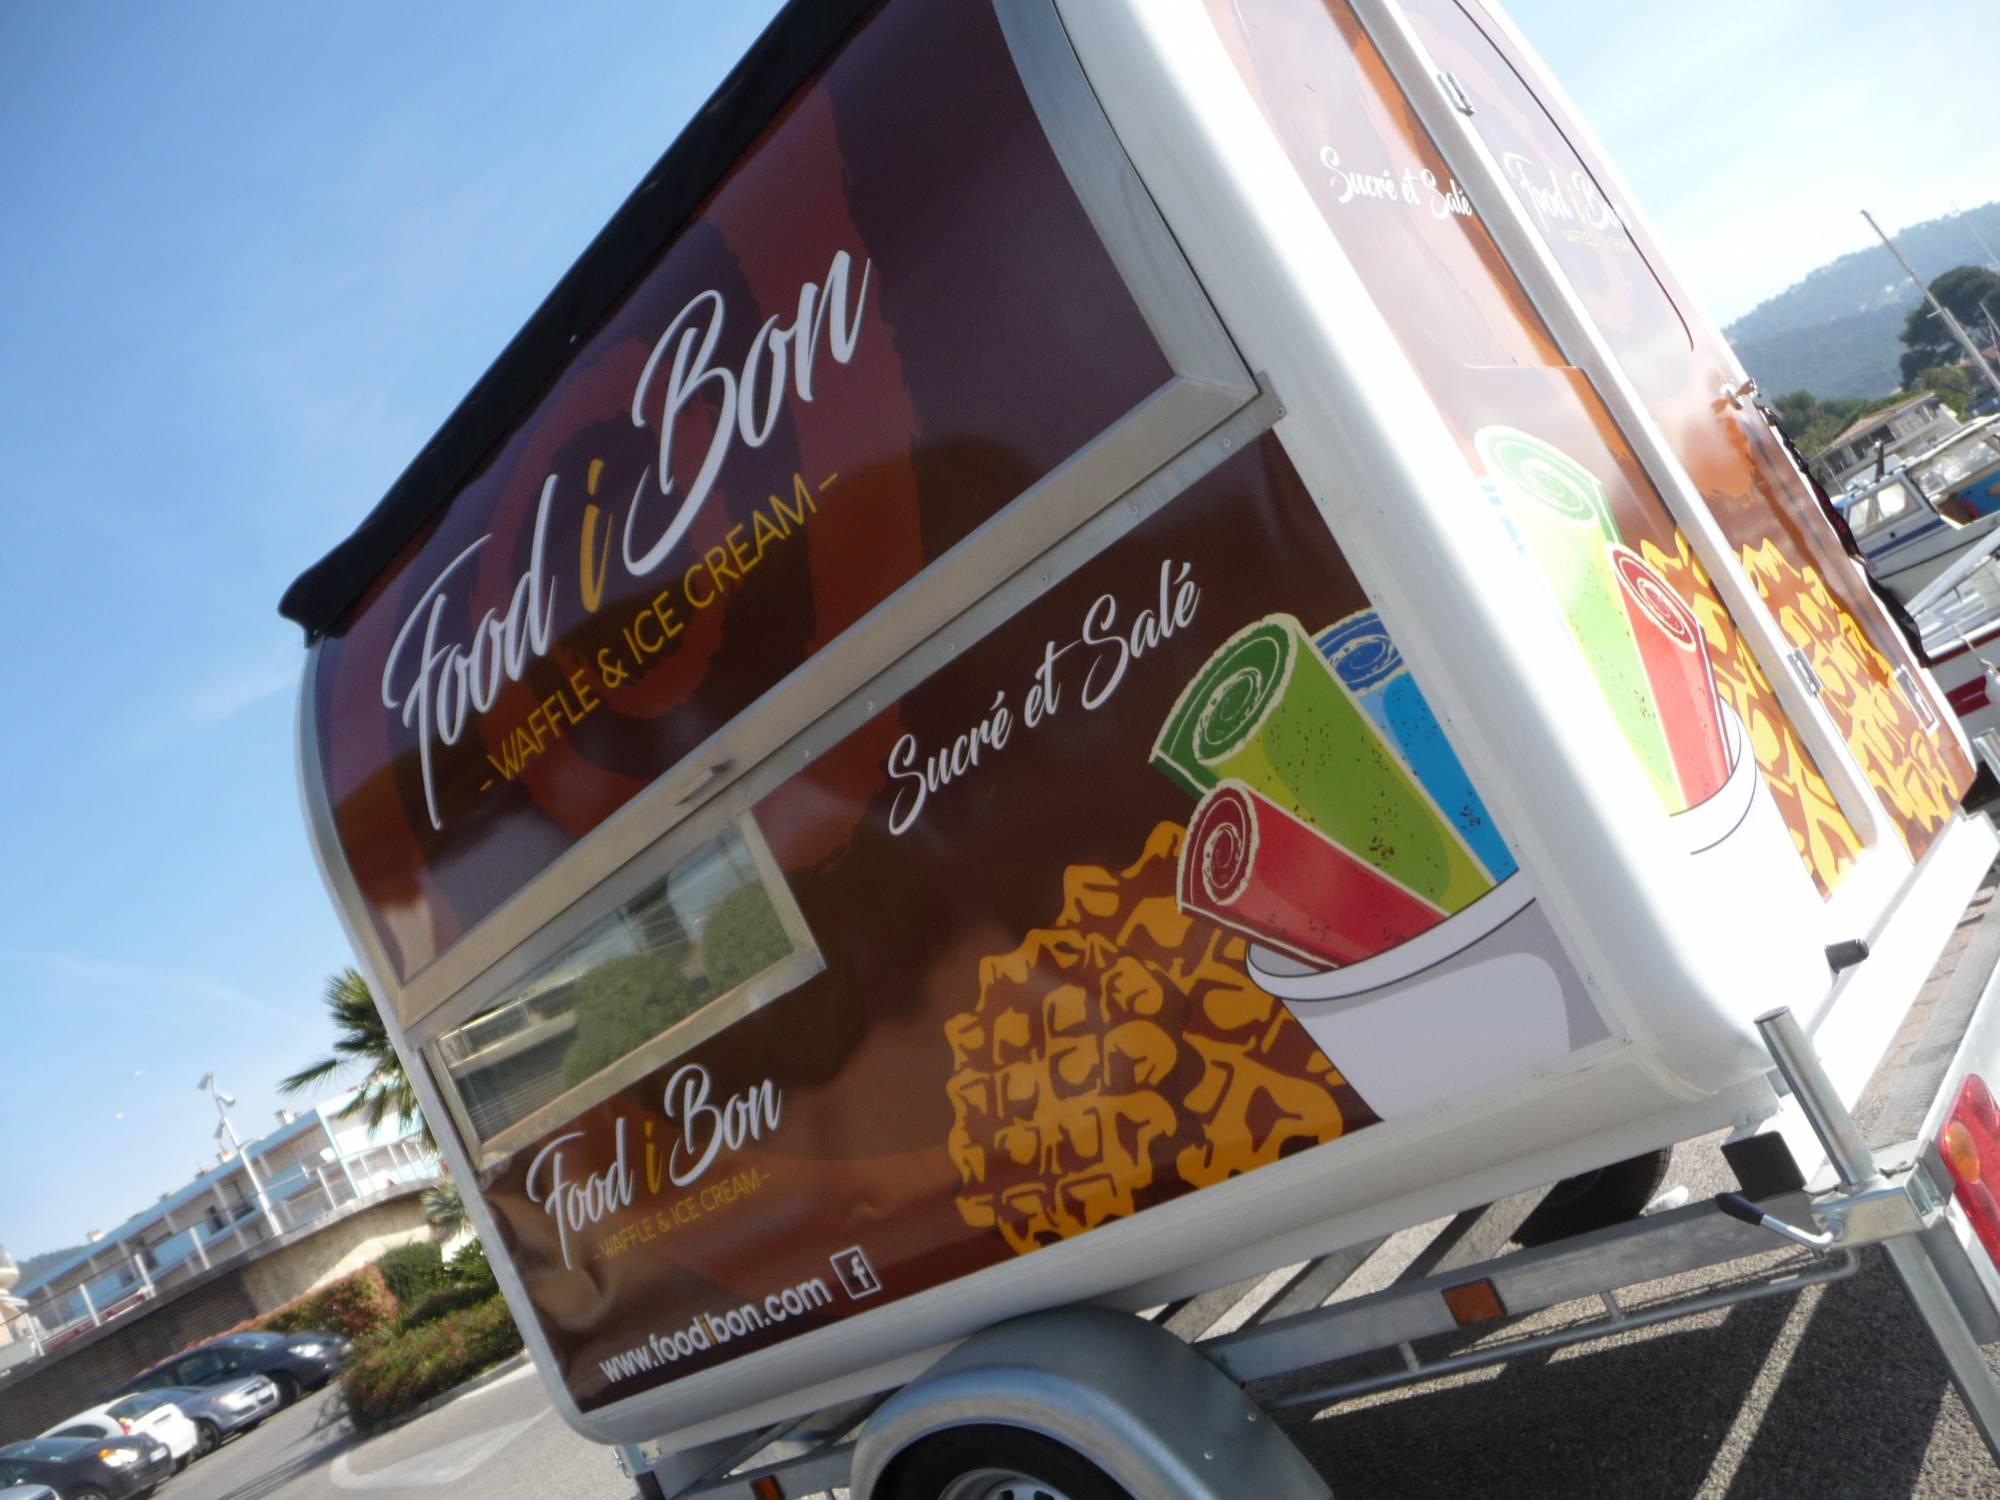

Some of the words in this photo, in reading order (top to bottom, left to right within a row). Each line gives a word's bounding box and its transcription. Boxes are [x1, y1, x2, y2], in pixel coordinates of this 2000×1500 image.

[382, 473, 556, 830] Food
[579, 457, 614, 613] i
[622, 250, 872, 577] Bon
[601, 648, 629, 688] &
[623, 591, 684, 667] ICE
[888, 690, 1014, 836] Sucré
[1024, 641, 1080, 728] et
[1081, 559, 1201, 711] Salé
[525, 1117, 634, 1271] Food
[644, 1120, 664, 1195] i
[664, 1063, 783, 1188] Bon
[655, 1211, 672, 1233] &
[670, 1196, 700, 1226] ICE
[599, 1276, 832, 1384] www.foodibon.com
